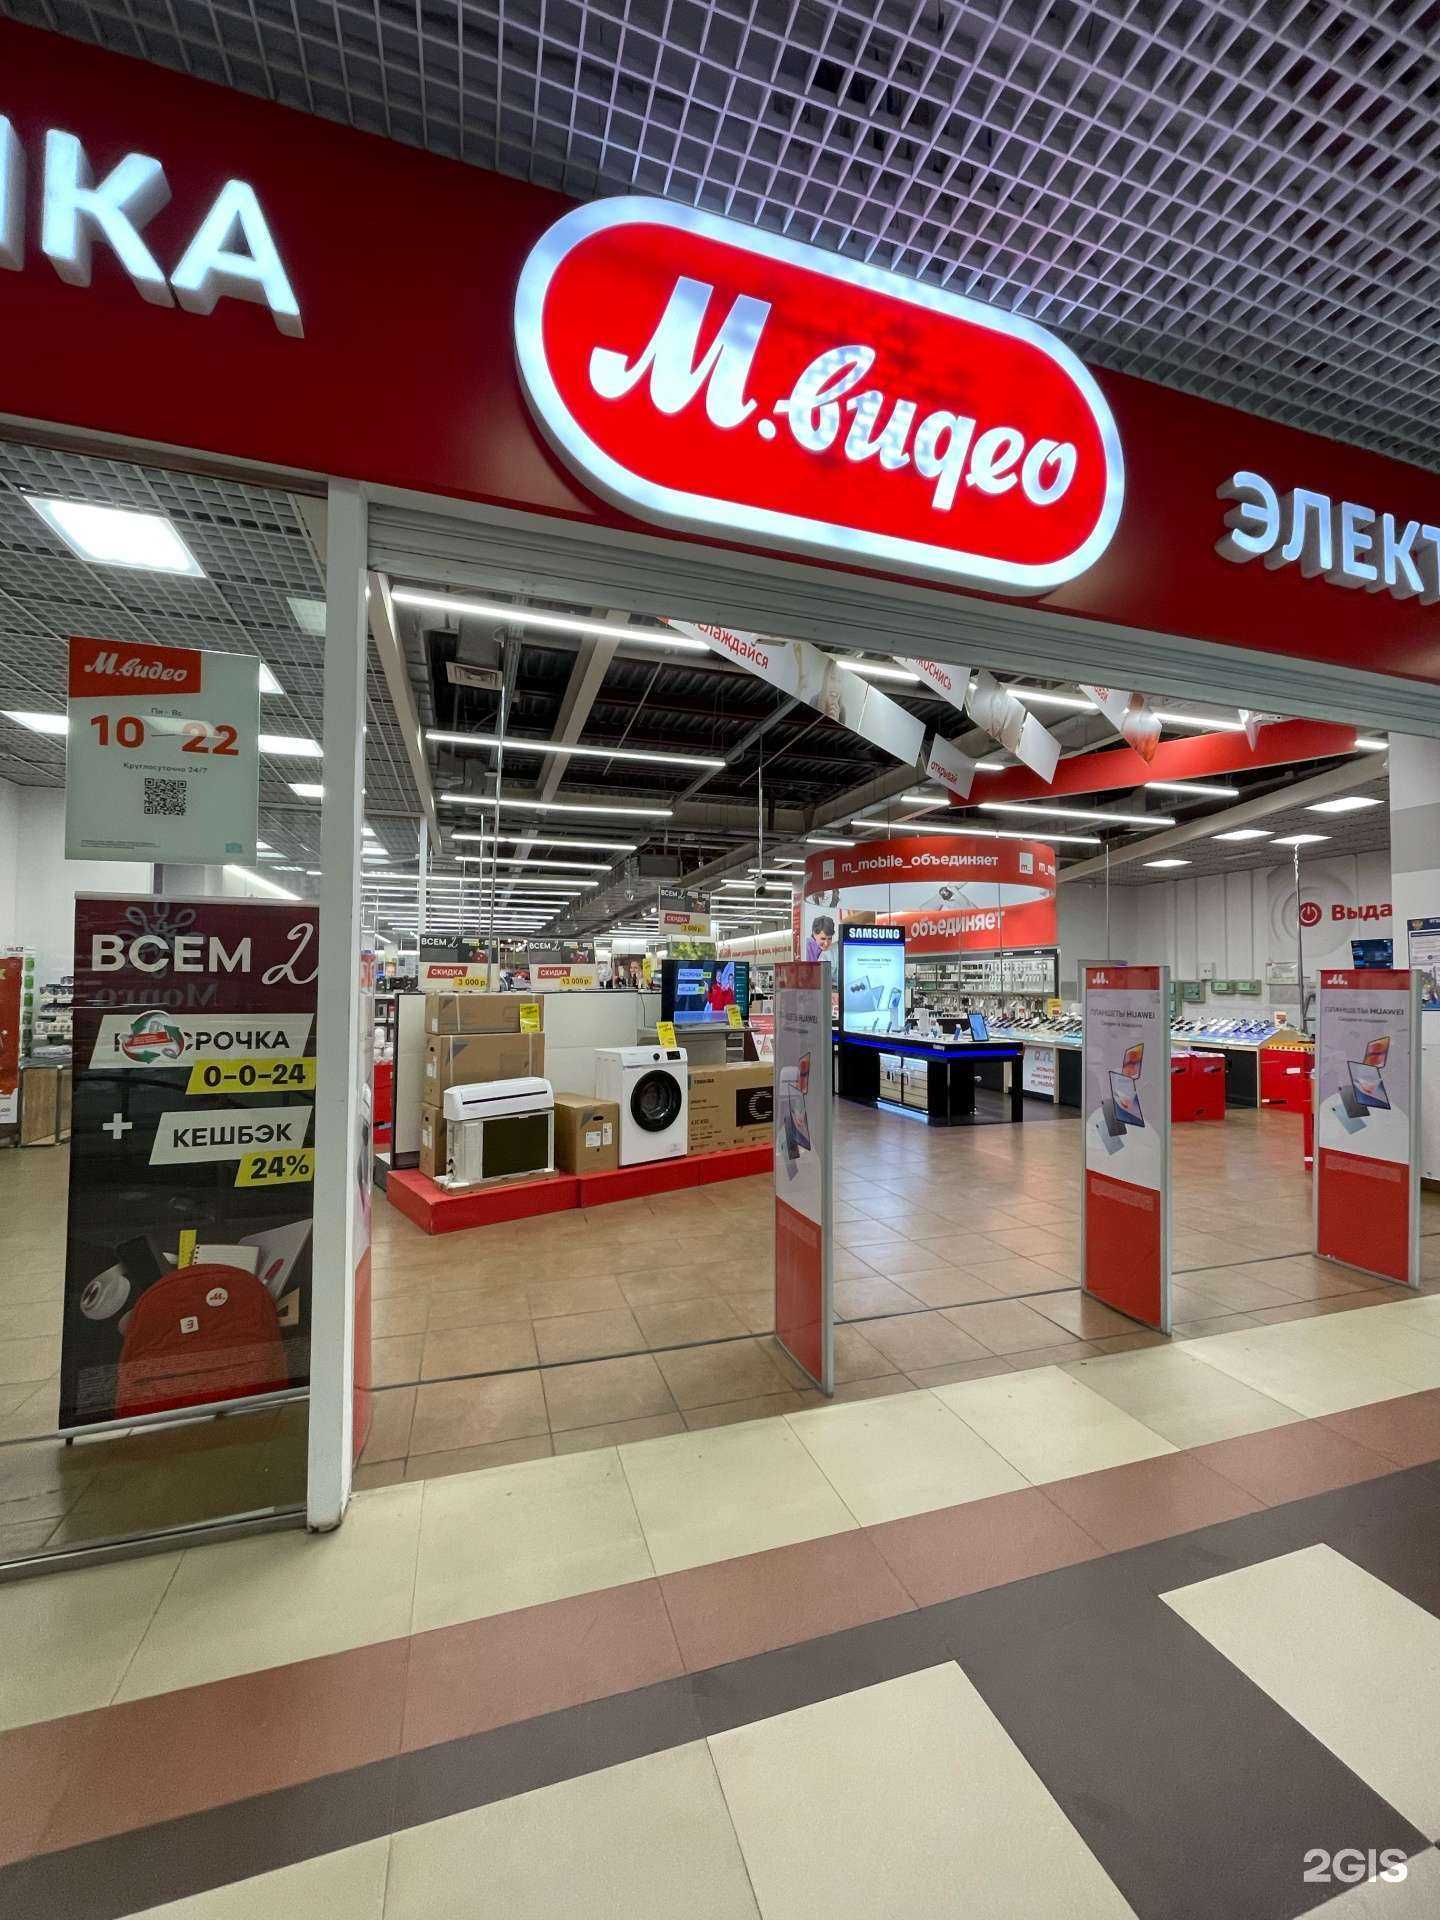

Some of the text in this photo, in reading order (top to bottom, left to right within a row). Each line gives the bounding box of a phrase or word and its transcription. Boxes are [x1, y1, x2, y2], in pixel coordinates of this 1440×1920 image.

[589, 274, 1078, 511] М.видео
[84, 651, 188, 682] М.видео
[91, 715, 239, 755] 10 22
[1332, 904, 1392, 921] Выда
[849, 928, 900, 939] SAMSUNG
[421, 938, 446, 946] ВСЕМ
[530, 942, 551, 950] ВСЕМ
[92, 934, 251, 974] ВСЕМ
[431, 968, 464, 976] СКИДКА
[540, 969, 568, 977] СКИДКА
[1126, 1010, 1156, 1019] HUAWEI
[1370, 1008, 1404, 1016] HUAWEI
[173, 1122, 293, 1148] КЕШБЭК
[251, 1155, 310, 1180] 24%
